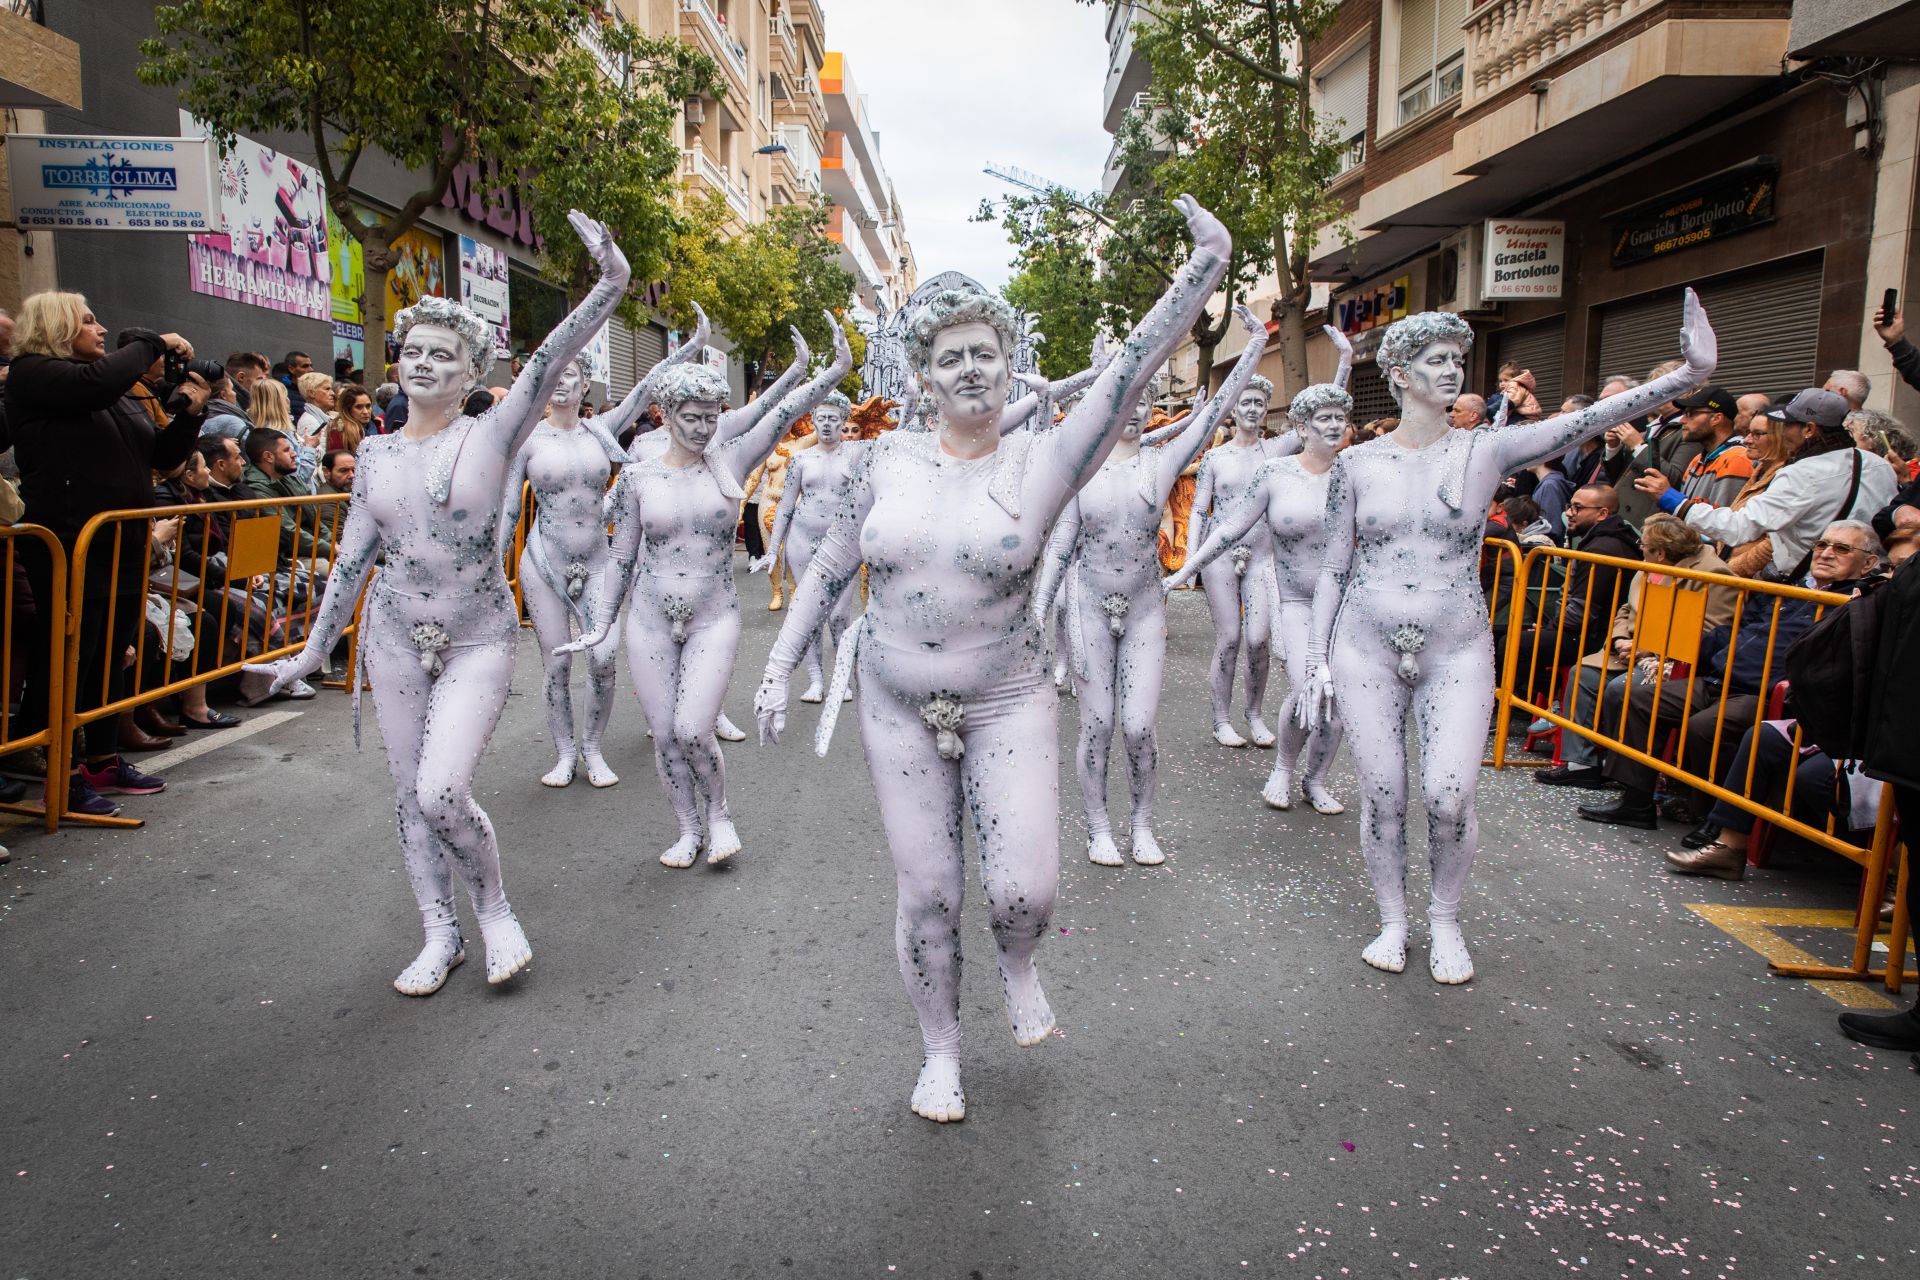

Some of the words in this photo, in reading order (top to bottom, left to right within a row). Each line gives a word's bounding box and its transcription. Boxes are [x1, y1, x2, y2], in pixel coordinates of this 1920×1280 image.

[39, 140, 174, 151] INSTALACIONES
[45, 169, 175, 187] TORRECLIMA
[21, 207, 85, 216] CONDUCTOS
[126, 210, 202, 218] ELECTRICIDAD
[58, 200, 83, 208] AIRE
[86, 201, 170, 209] ACONDICIONADO
[33, 216, 55, 225] 653
[59, 217, 73, 225] 80
[77, 218, 92, 226] 58
[95, 218, 109, 226] 61
[129, 219, 151, 227] 653
[155, 219, 169, 227] 80
[173, 219, 187, 228] 58
[191, 219, 205, 228] 62
[1630, 220, 1675, 247] Graciela
[1681, 199, 1745, 231] Bortolotto
[1506, 239, 1549, 249] Unisex
[1653, 227, 1712, 254] 966705905
[1494, 249, 1547, 266] Graciela
[1494, 264, 1560, 283] Bortolotto
[200, 262, 324, 311] HERRAMIENTAS
[1501, 285, 1512, 293] 96
[1515, 285, 1531, 293] 670
[1533, 285, 1544, 293] 59
[1546, 285, 1558, 293] 05
[331, 320, 365, 340] CELEBR
